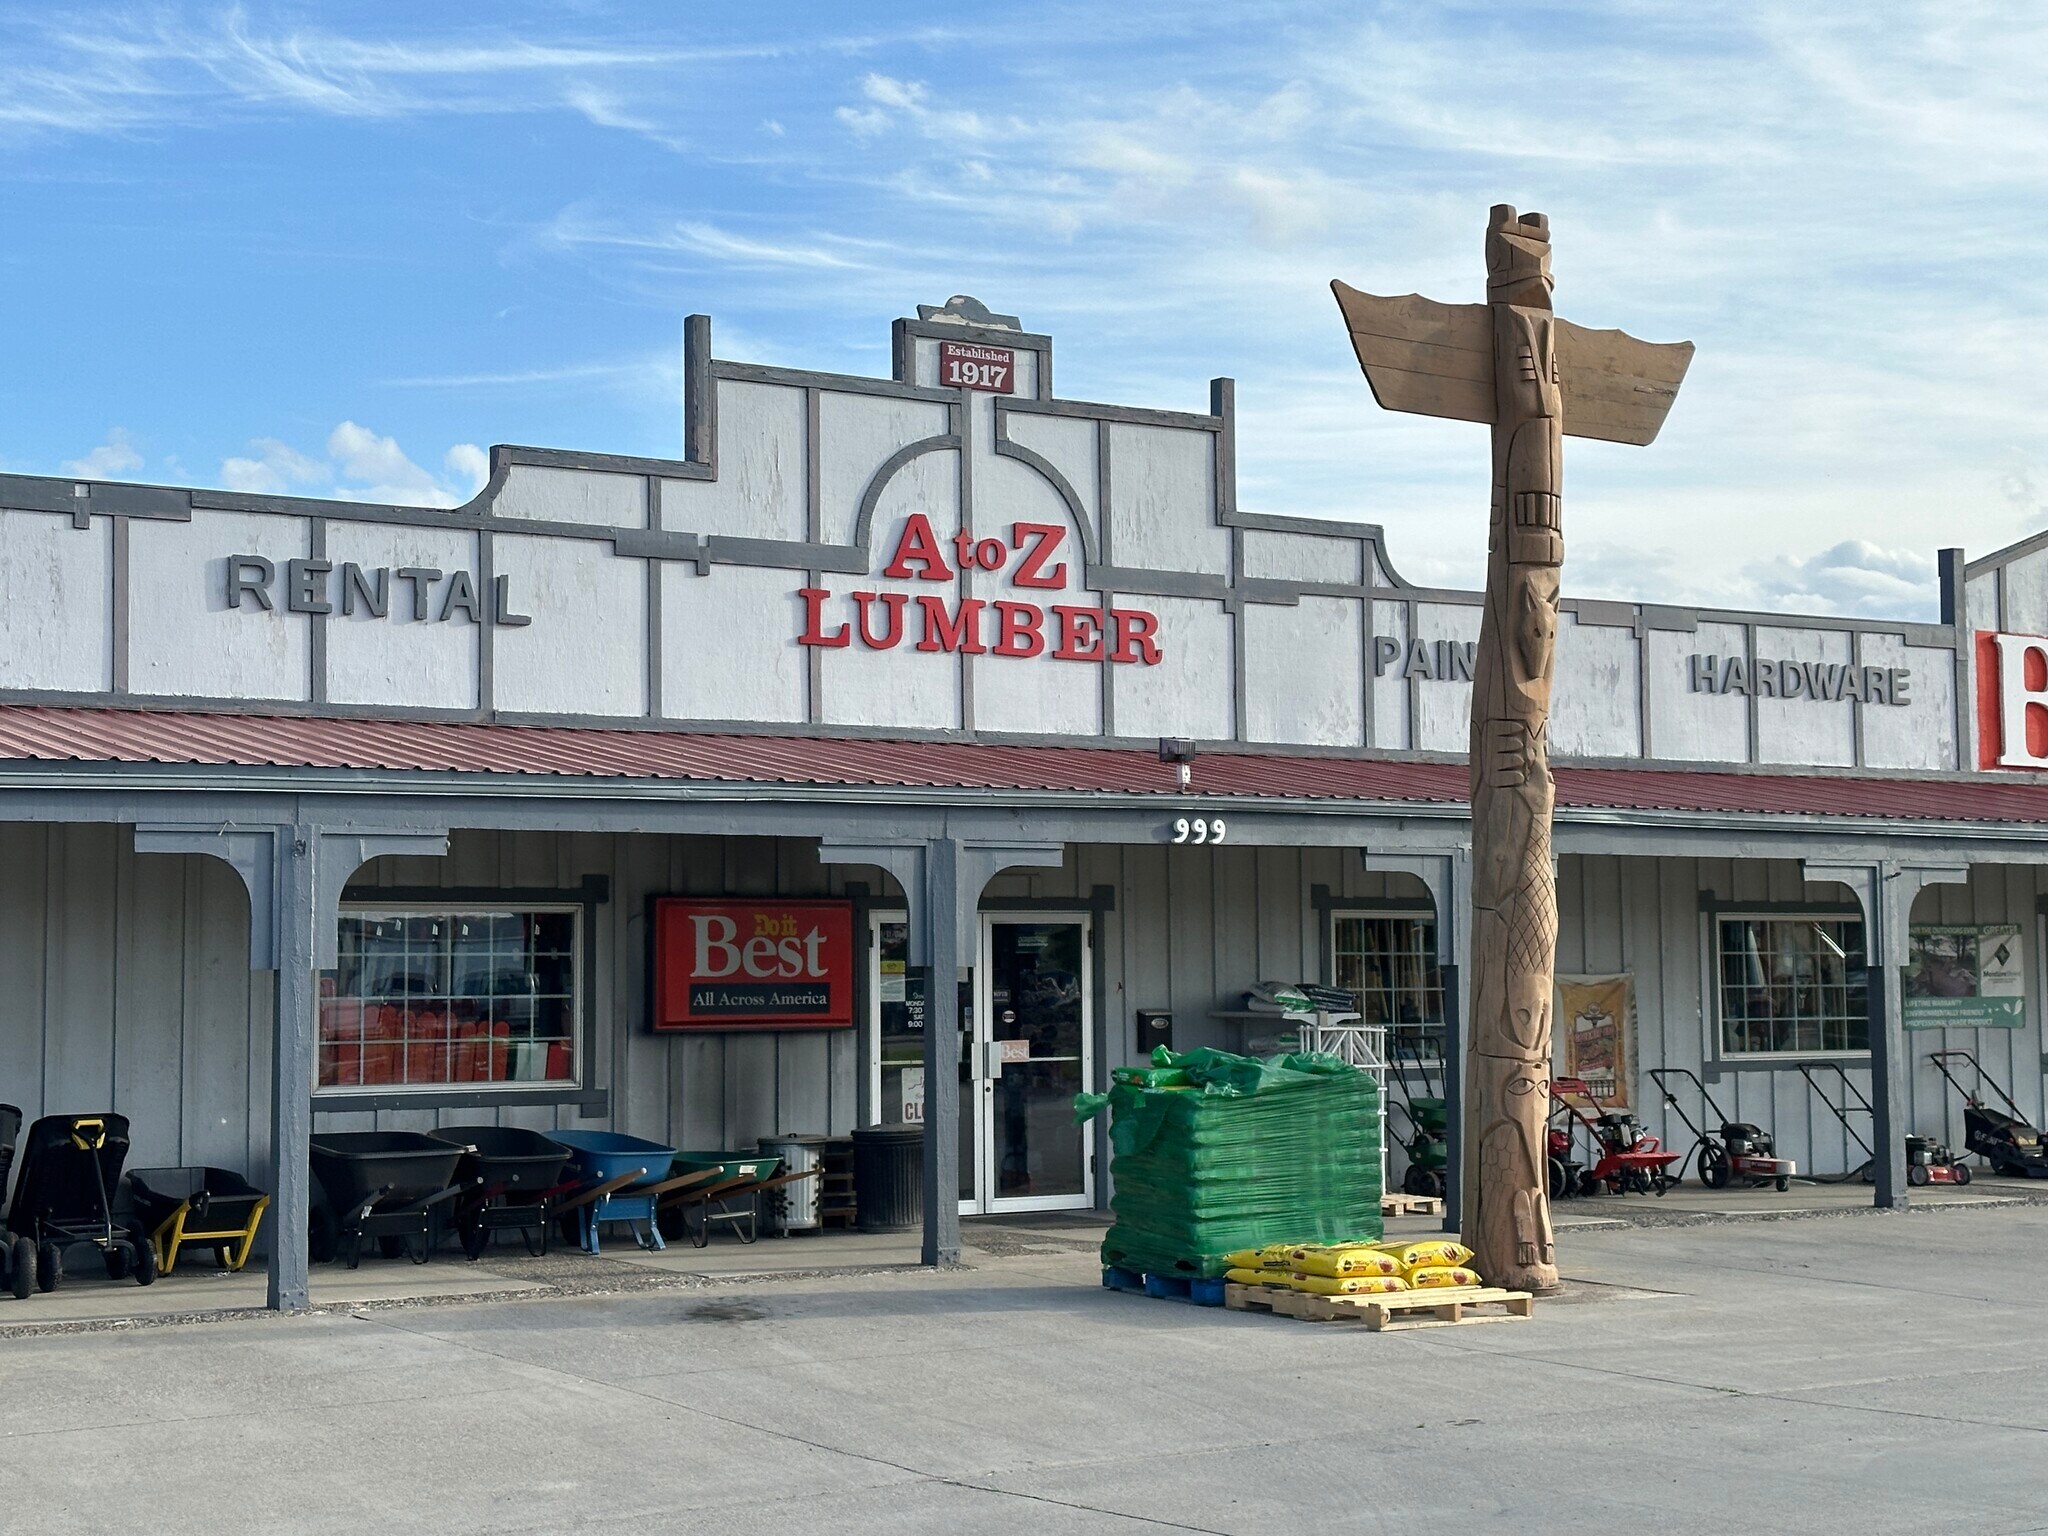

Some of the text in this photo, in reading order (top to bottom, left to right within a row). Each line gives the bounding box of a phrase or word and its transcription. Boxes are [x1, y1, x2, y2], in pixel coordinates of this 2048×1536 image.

[947, 344, 1010, 363] Established
[949, 360, 1007, 388] 1917
[884, 513, 1066, 589] A to Z
[228, 554, 532, 626] RENTAL
[798, 588, 1162, 665] LUMBER
[1692, 653, 1911, 706] HARDWARE
[1171, 818, 1226, 845] 999
[754, 912, 798, 936] Do it
[688, 914, 829, 978] Best
[693, 991, 828, 1006] All Across America
